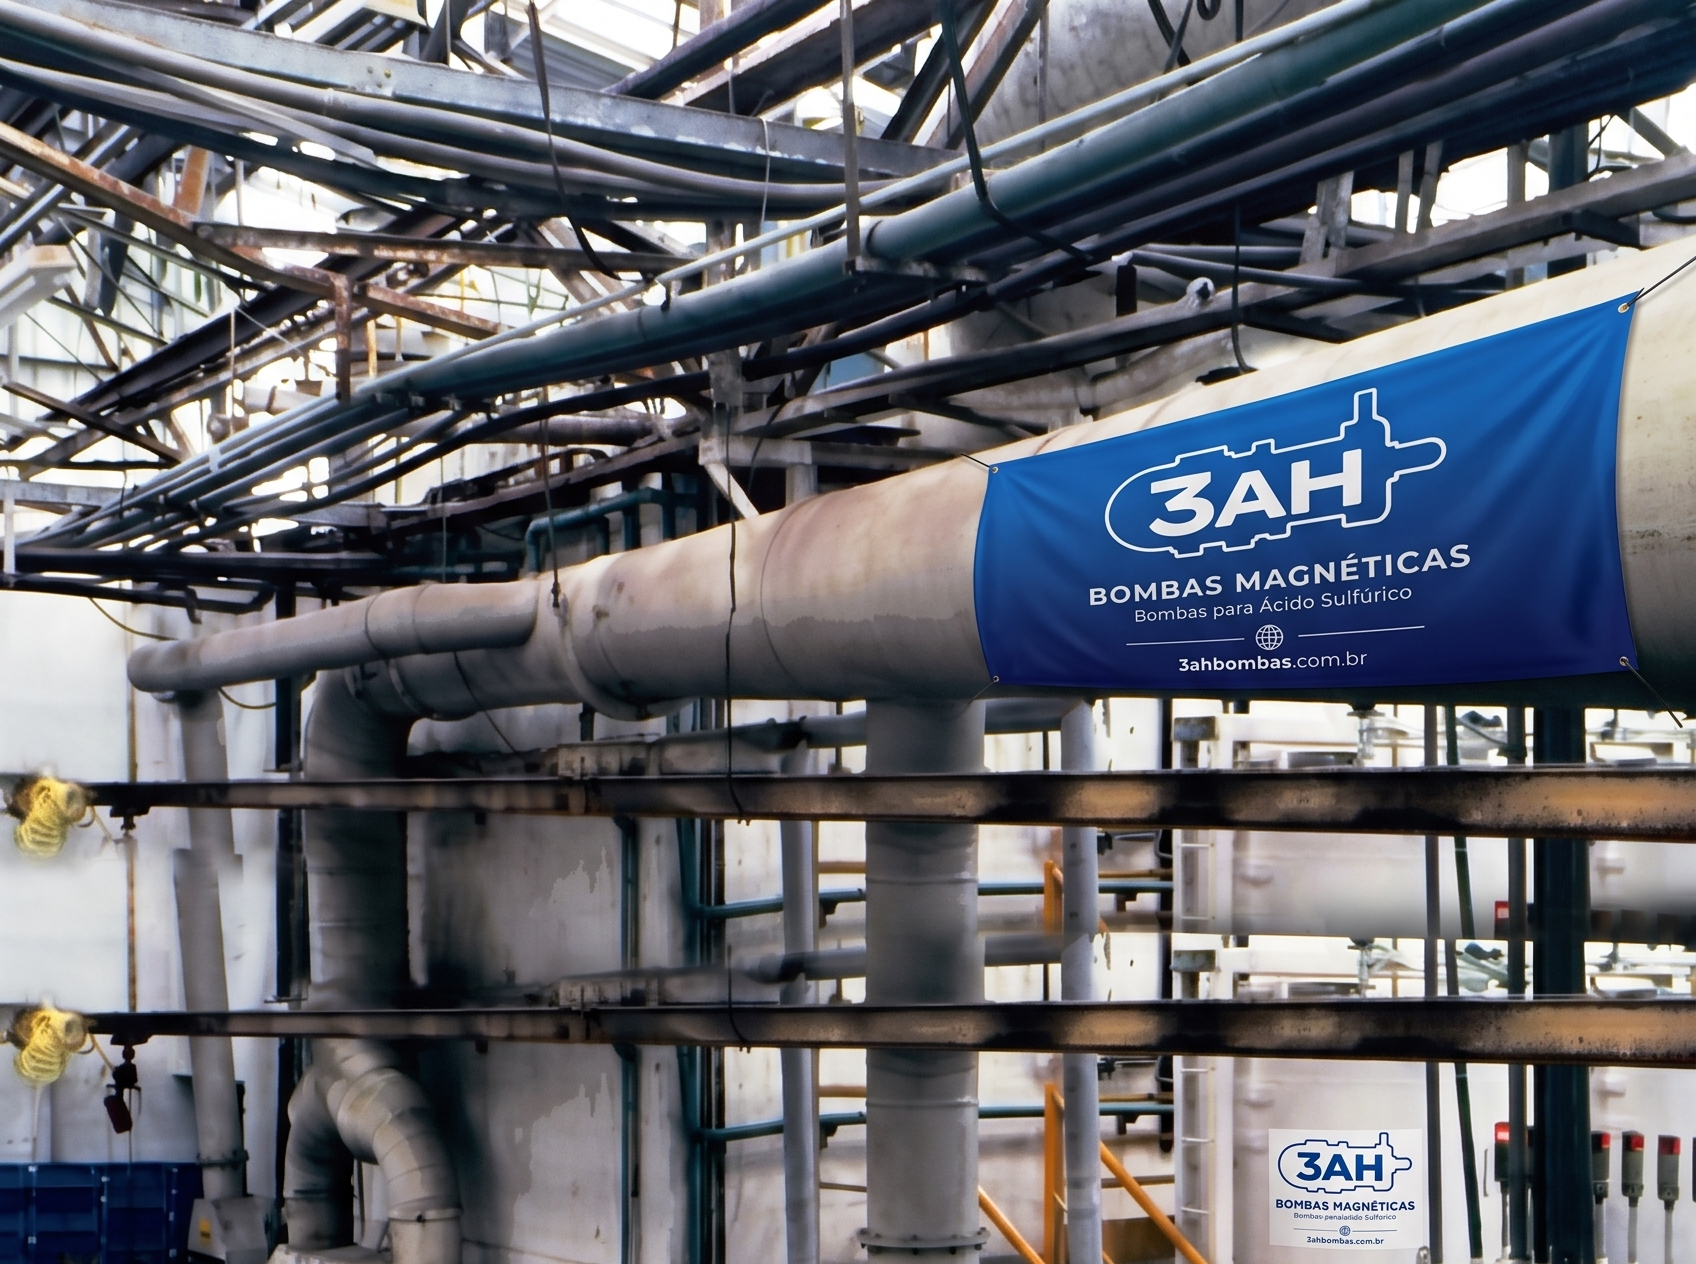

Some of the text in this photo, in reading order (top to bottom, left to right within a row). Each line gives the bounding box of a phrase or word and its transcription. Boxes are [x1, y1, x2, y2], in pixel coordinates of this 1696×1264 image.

[1148, 448, 1363, 537] 3AH
[1088, 543, 1471, 607] BOMBAS MAGNÉTICAS
[1134, 585, 1412, 624] Bombas para Ácido Sulfúrico
[1178, 650, 1368, 672] 3ahbombas.com.br
[1296, 1152, 1383, 1181] 3AH
[1275, 1199, 1329, 1211] BOMBAS
